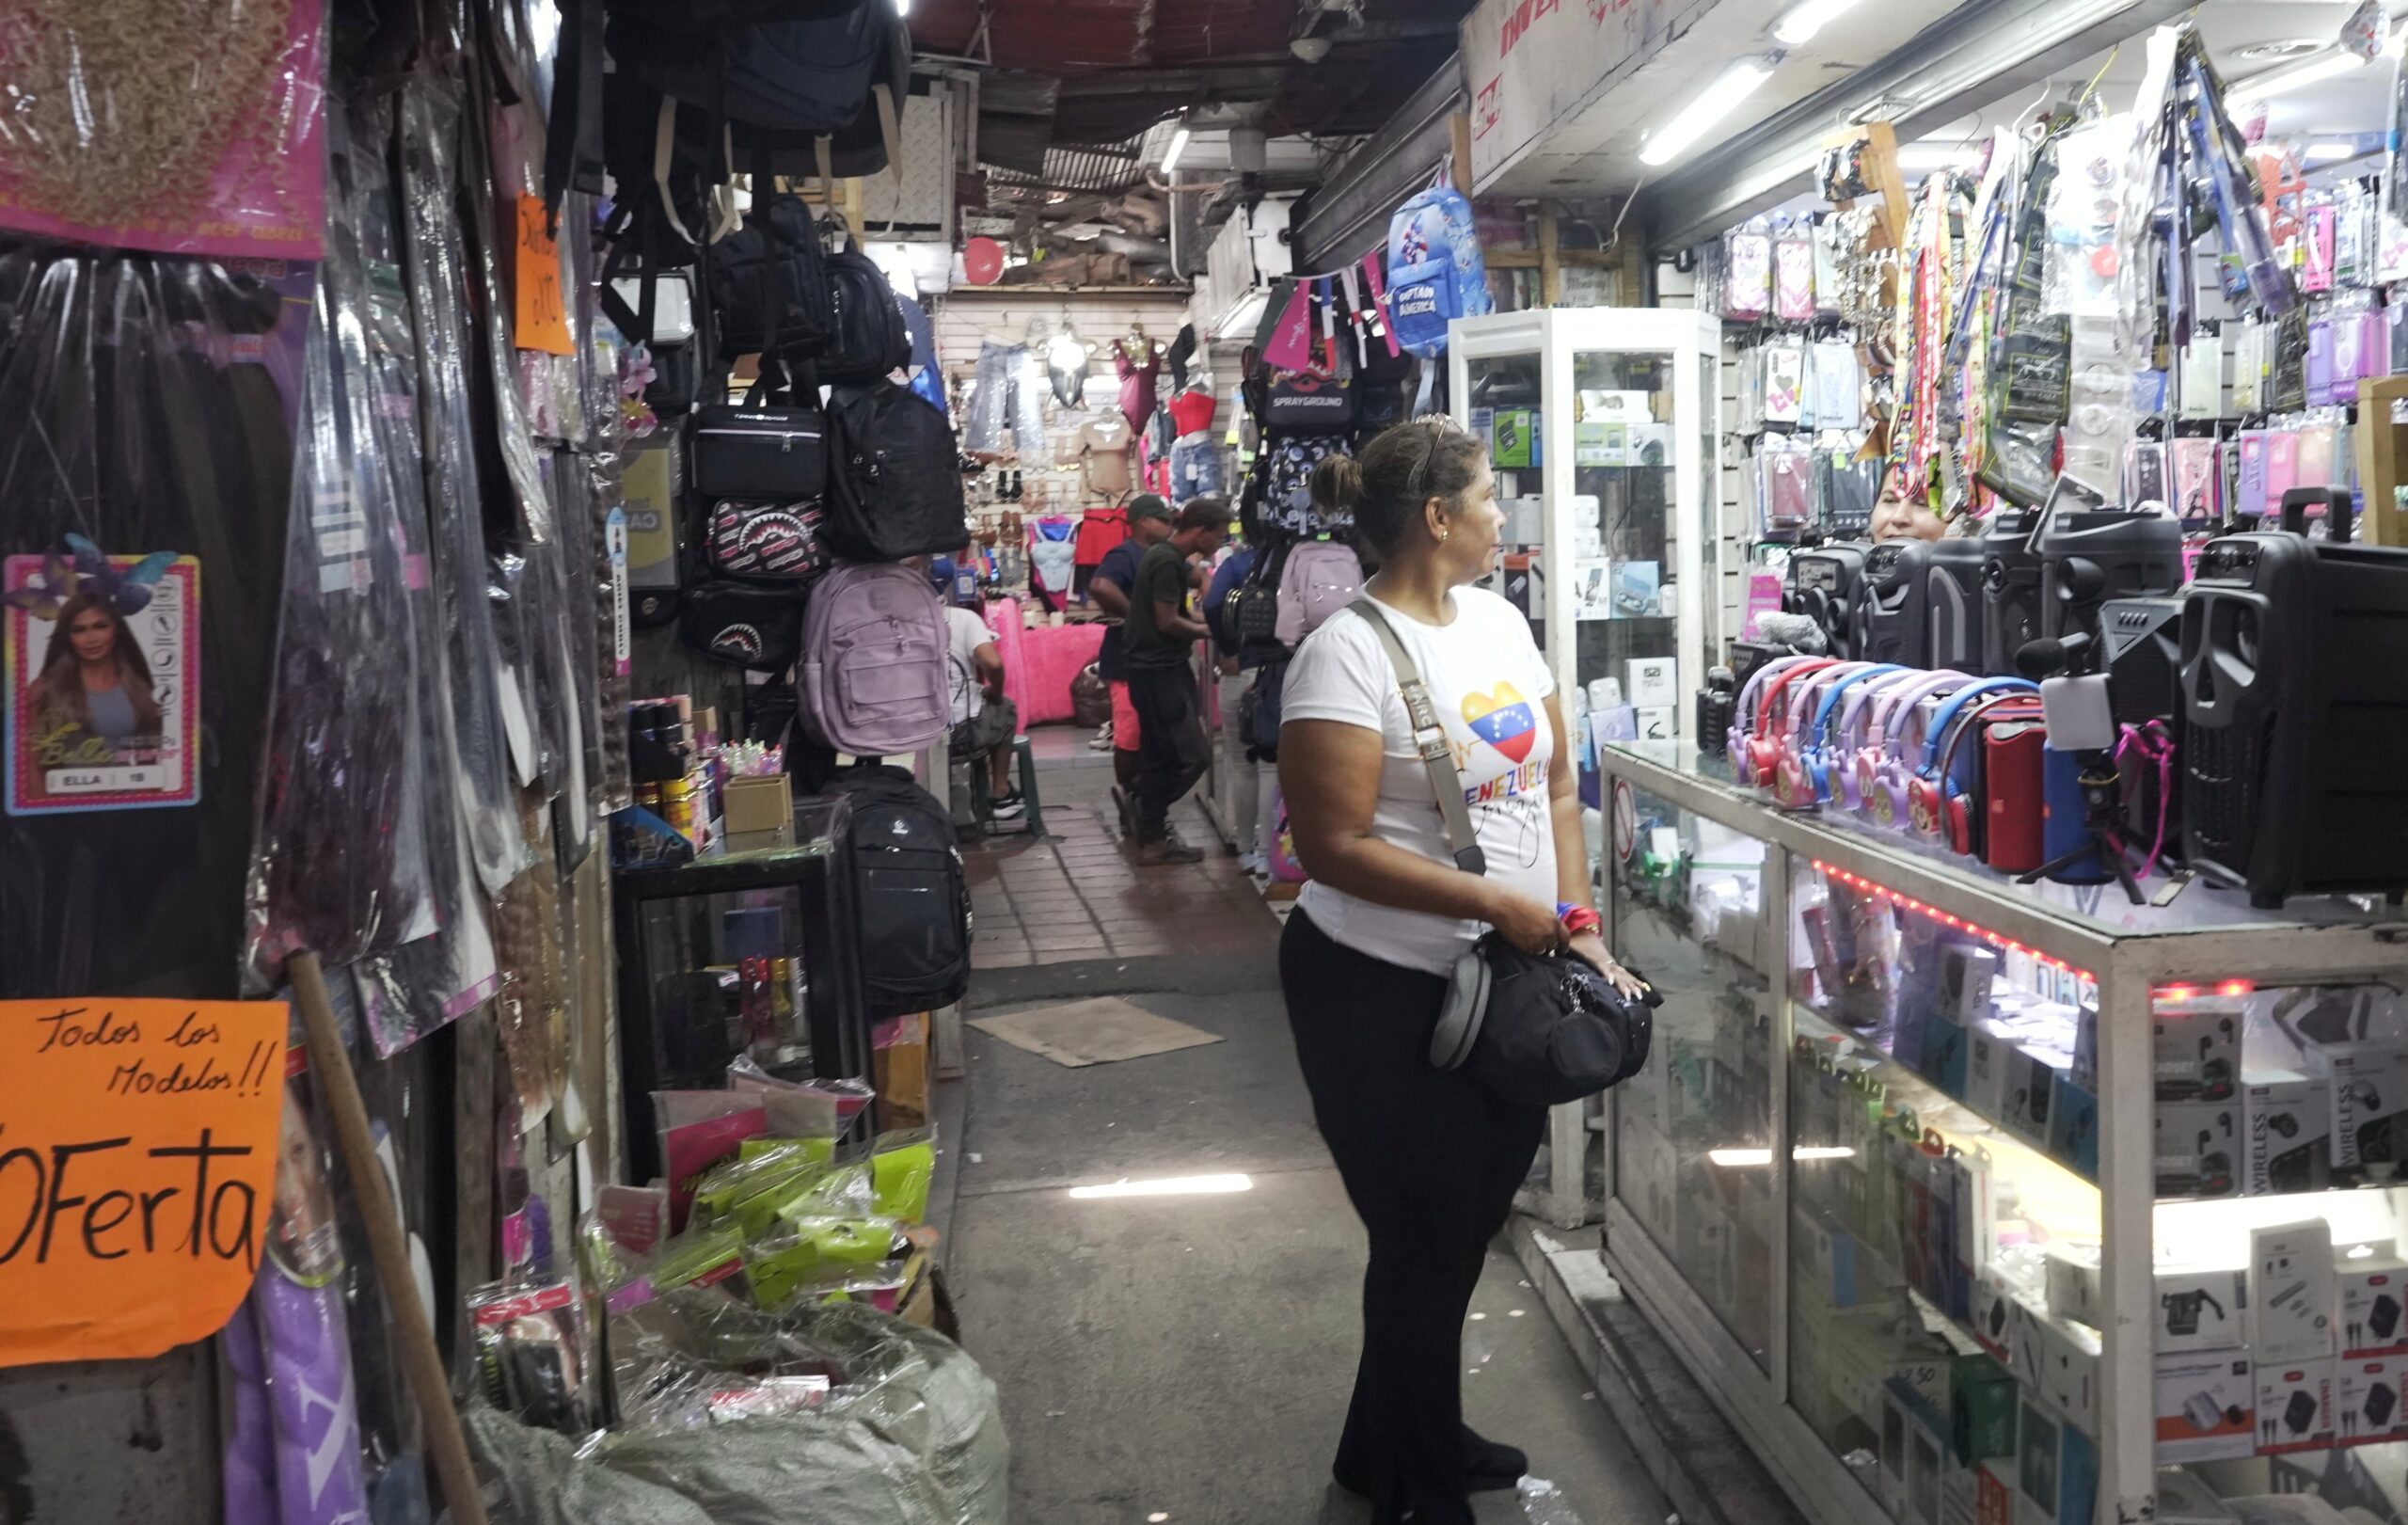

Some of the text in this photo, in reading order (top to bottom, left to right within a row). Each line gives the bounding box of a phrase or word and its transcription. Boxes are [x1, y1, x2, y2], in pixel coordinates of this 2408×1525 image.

[1273, 396, 1343, 407] SPRAYGROUND
[63, 774, 102, 786] ELLA
[1465, 755, 1551, 806] ENEZUEL
[37, 1007, 220, 1053] Todos los
[106, 1040, 277, 1097] Modelos!!
[2338, 1083, 2355, 1168] WIRELESS
[2252, 1112, 2268, 1196] WIRELESS
